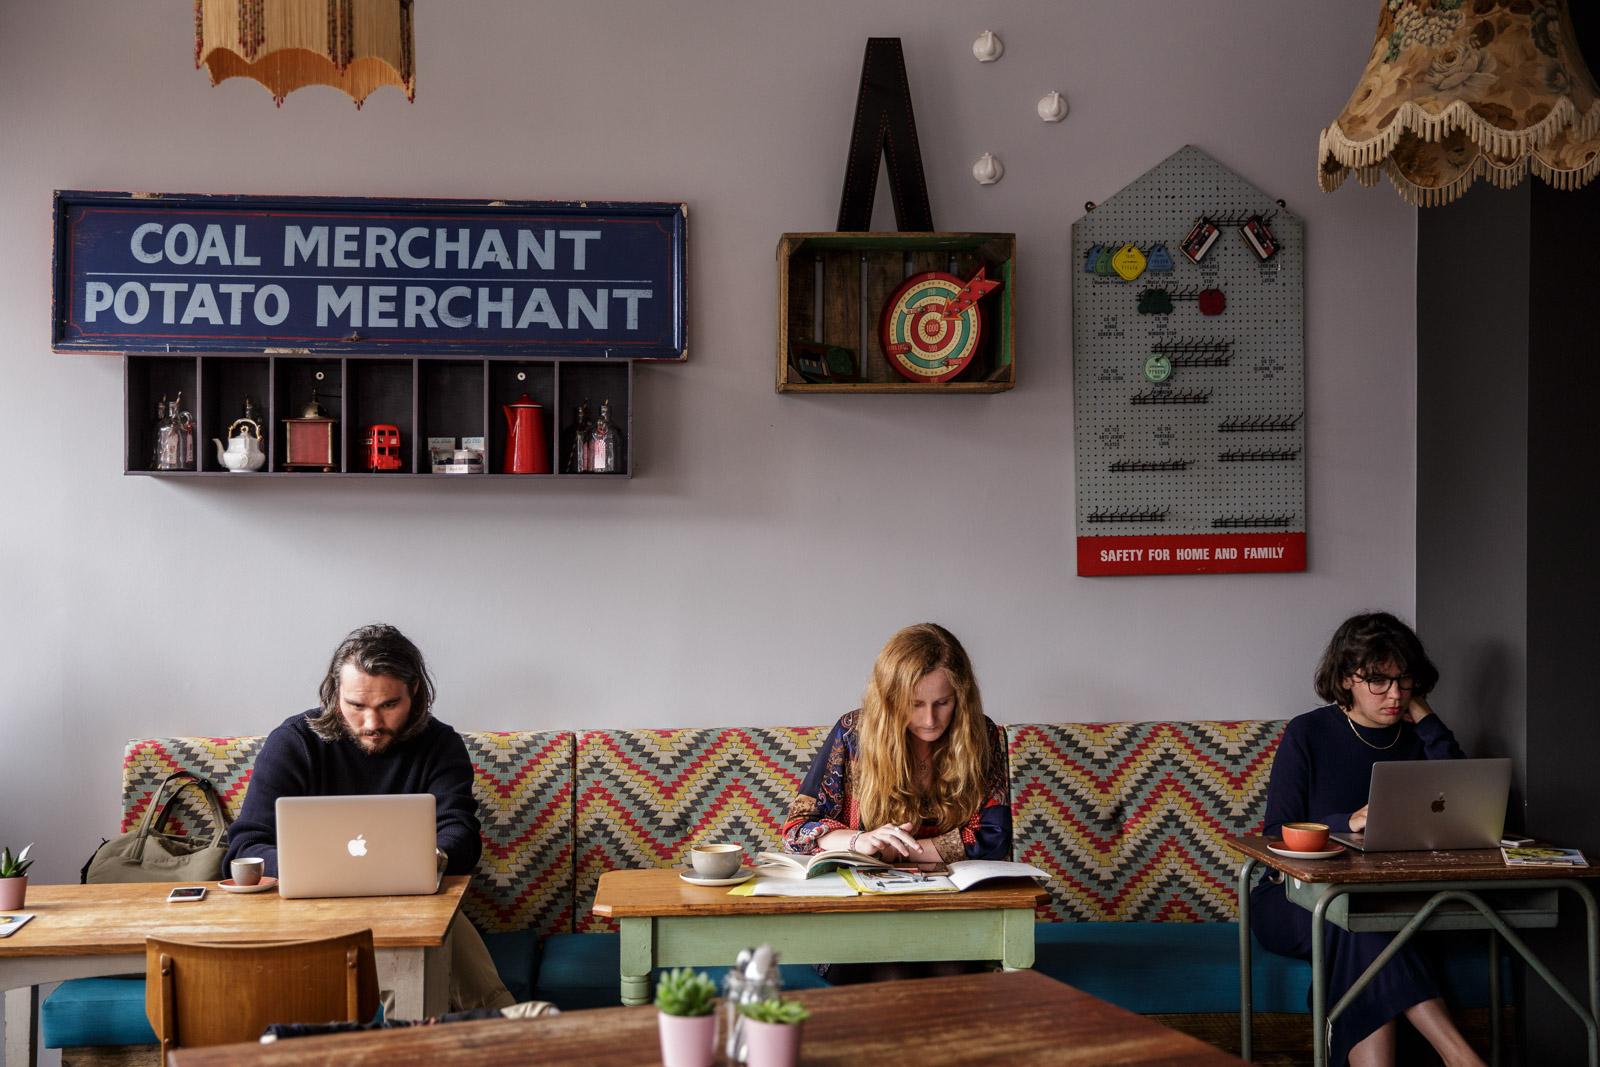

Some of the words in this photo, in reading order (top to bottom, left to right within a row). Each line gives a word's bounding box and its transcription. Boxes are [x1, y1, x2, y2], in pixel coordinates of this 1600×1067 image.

[130, 222, 261, 266] COAL
[283, 224, 602, 271] MERCHANT
[85, 281, 291, 326] POTATO
[316, 285, 653, 330] MERCHANT
[926, 324, 938, 332] 1000
[1100, 549, 1143, 562] SAFETY
[1148, 549, 1170, 561] FOR
[1176, 548, 1210, 560] HOME
[1214, 547, 1238, 560] AND
[1244, 547, 1285, 559] FAMILY
